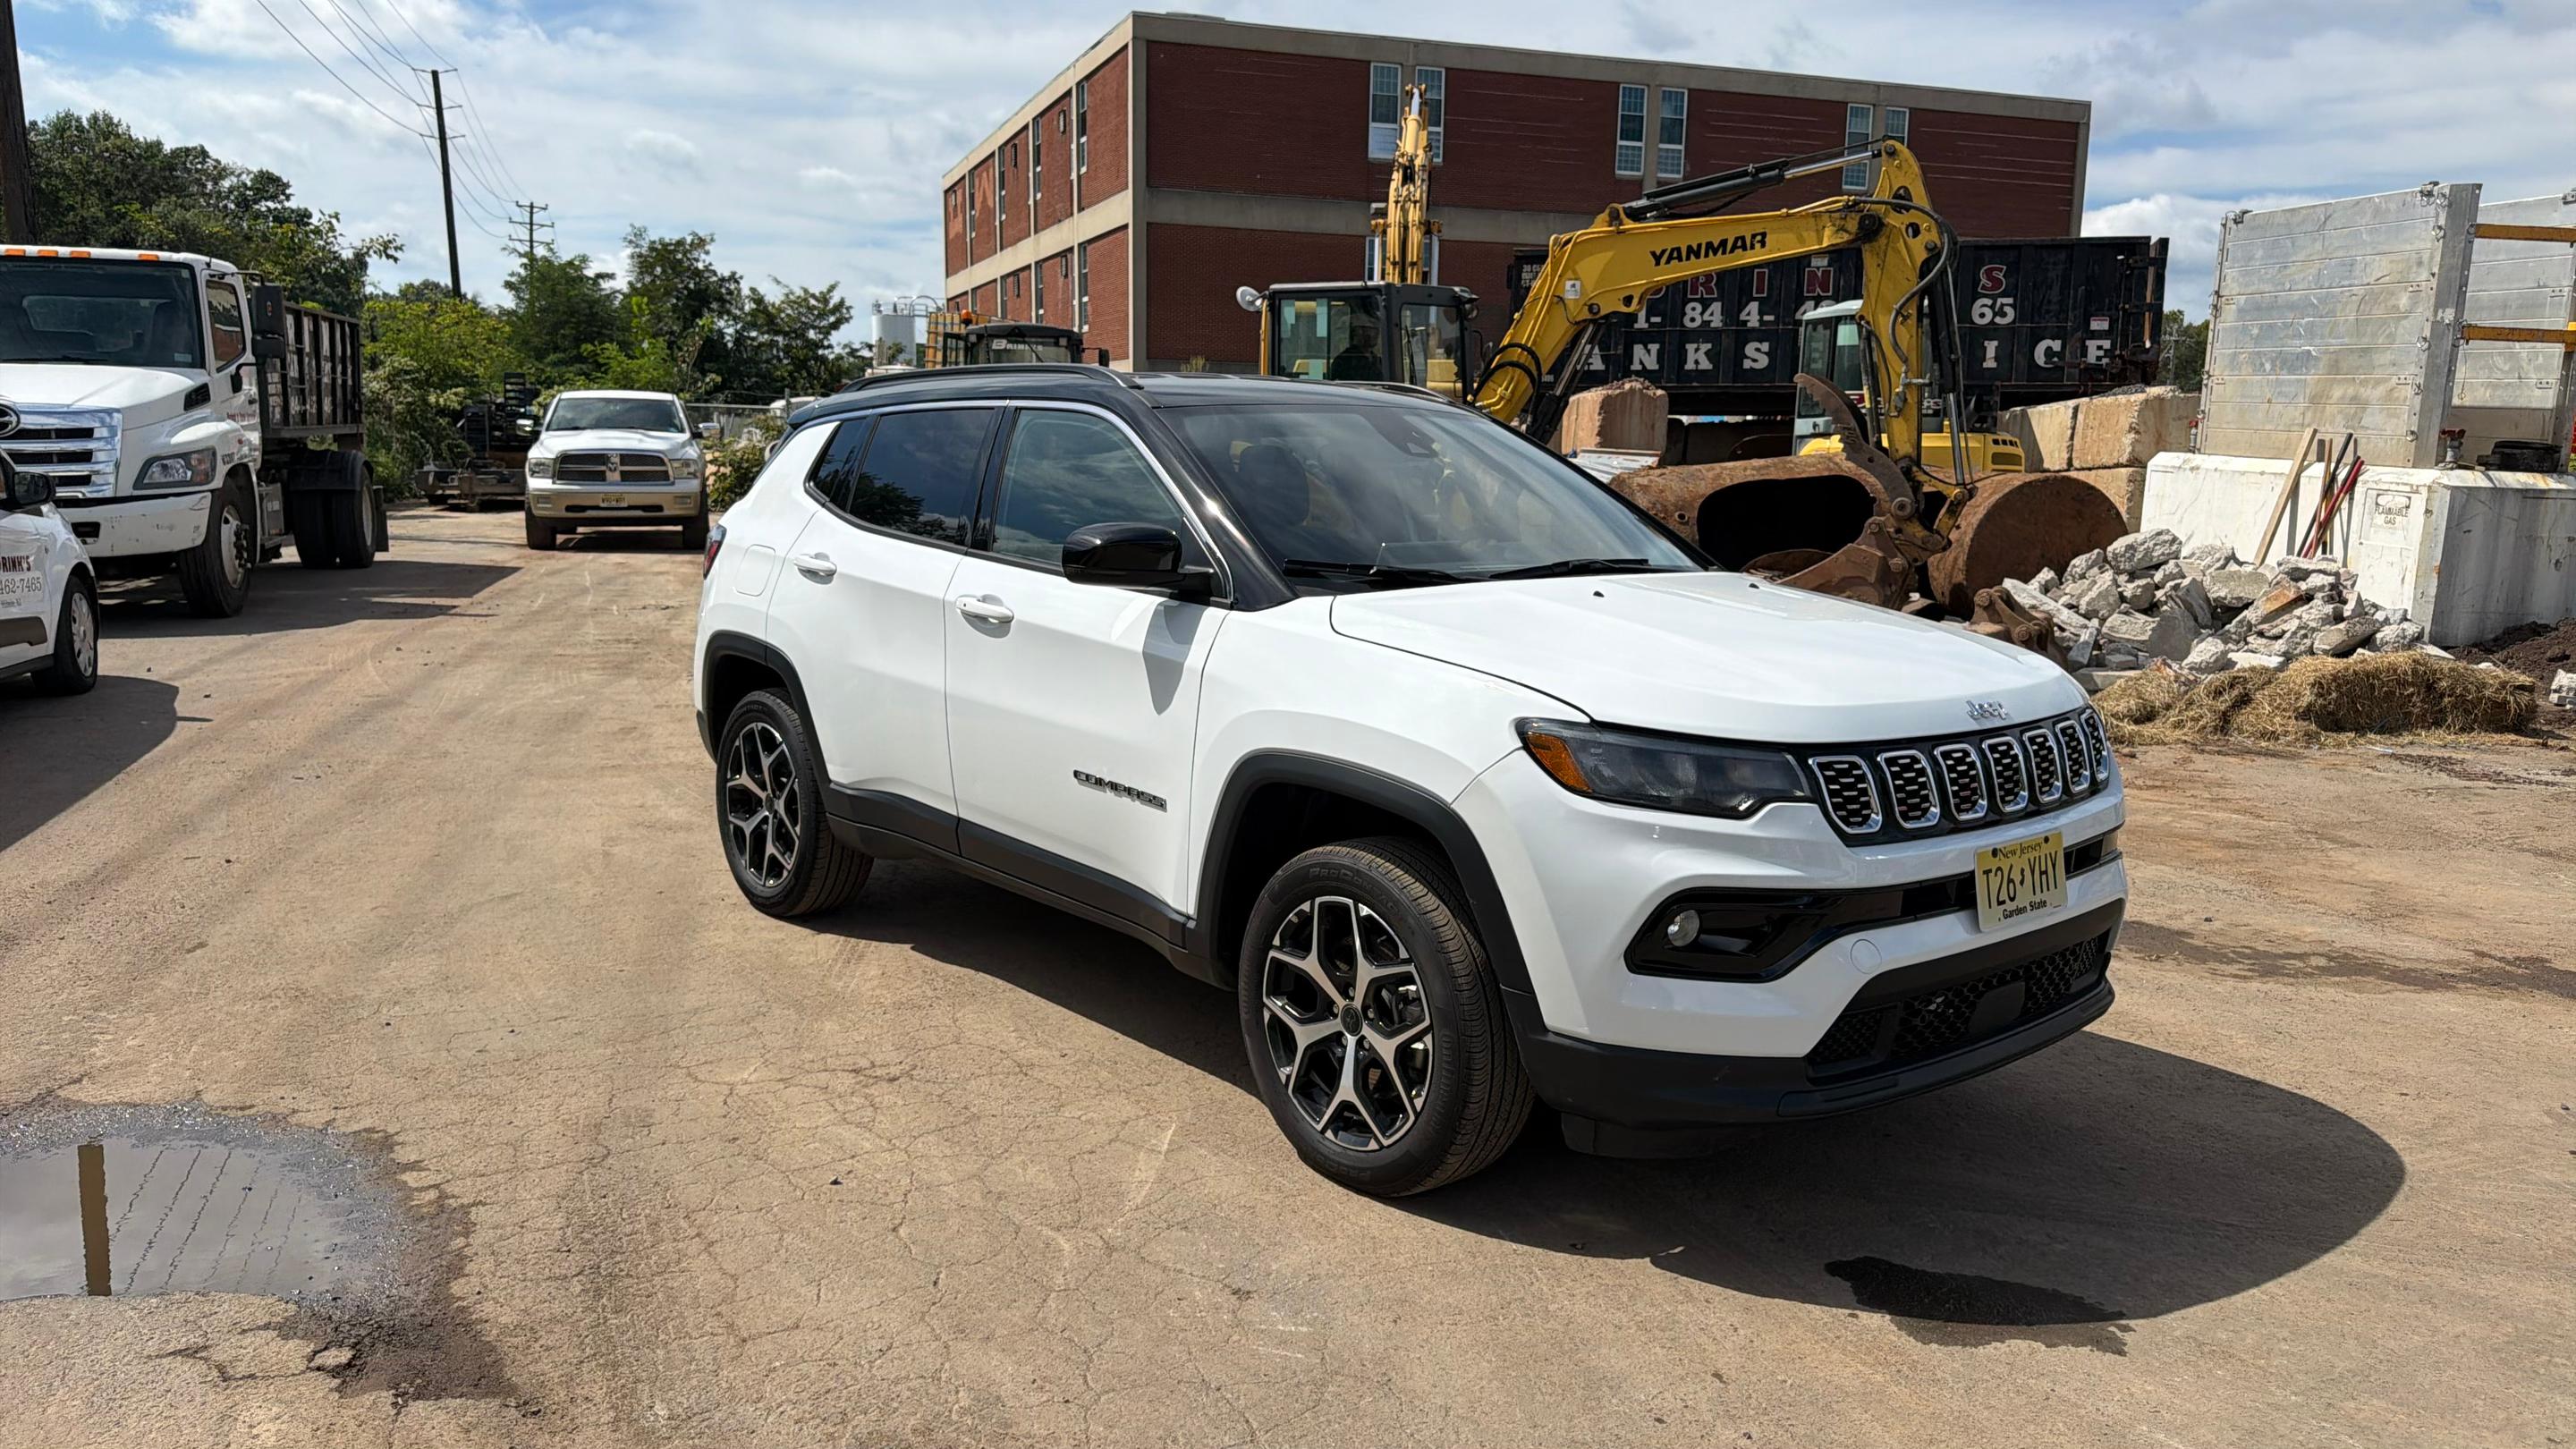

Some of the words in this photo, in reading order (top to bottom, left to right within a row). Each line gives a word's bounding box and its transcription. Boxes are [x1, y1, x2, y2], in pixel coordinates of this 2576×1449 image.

[1649, 231, 1767, 267] YANMAR
[2375, 505, 2409, 518] FLAMMABLE
[2384, 516, 2397, 526] GAS
[0, 555, 32, 572] RINK'S
[1966, 700, 2006, 721] Jeep
[1073, 769, 1167, 809] COMPASS
[1998, 846, 2018, 861] New
[2019, 841, 2043, 859] Jersey
[1982, 862, 2017, 910] T26
[2028, 850, 2058, 896] YHY
[2003, 905, 2028, 919] Garden
[2029, 898, 2047, 911] State
